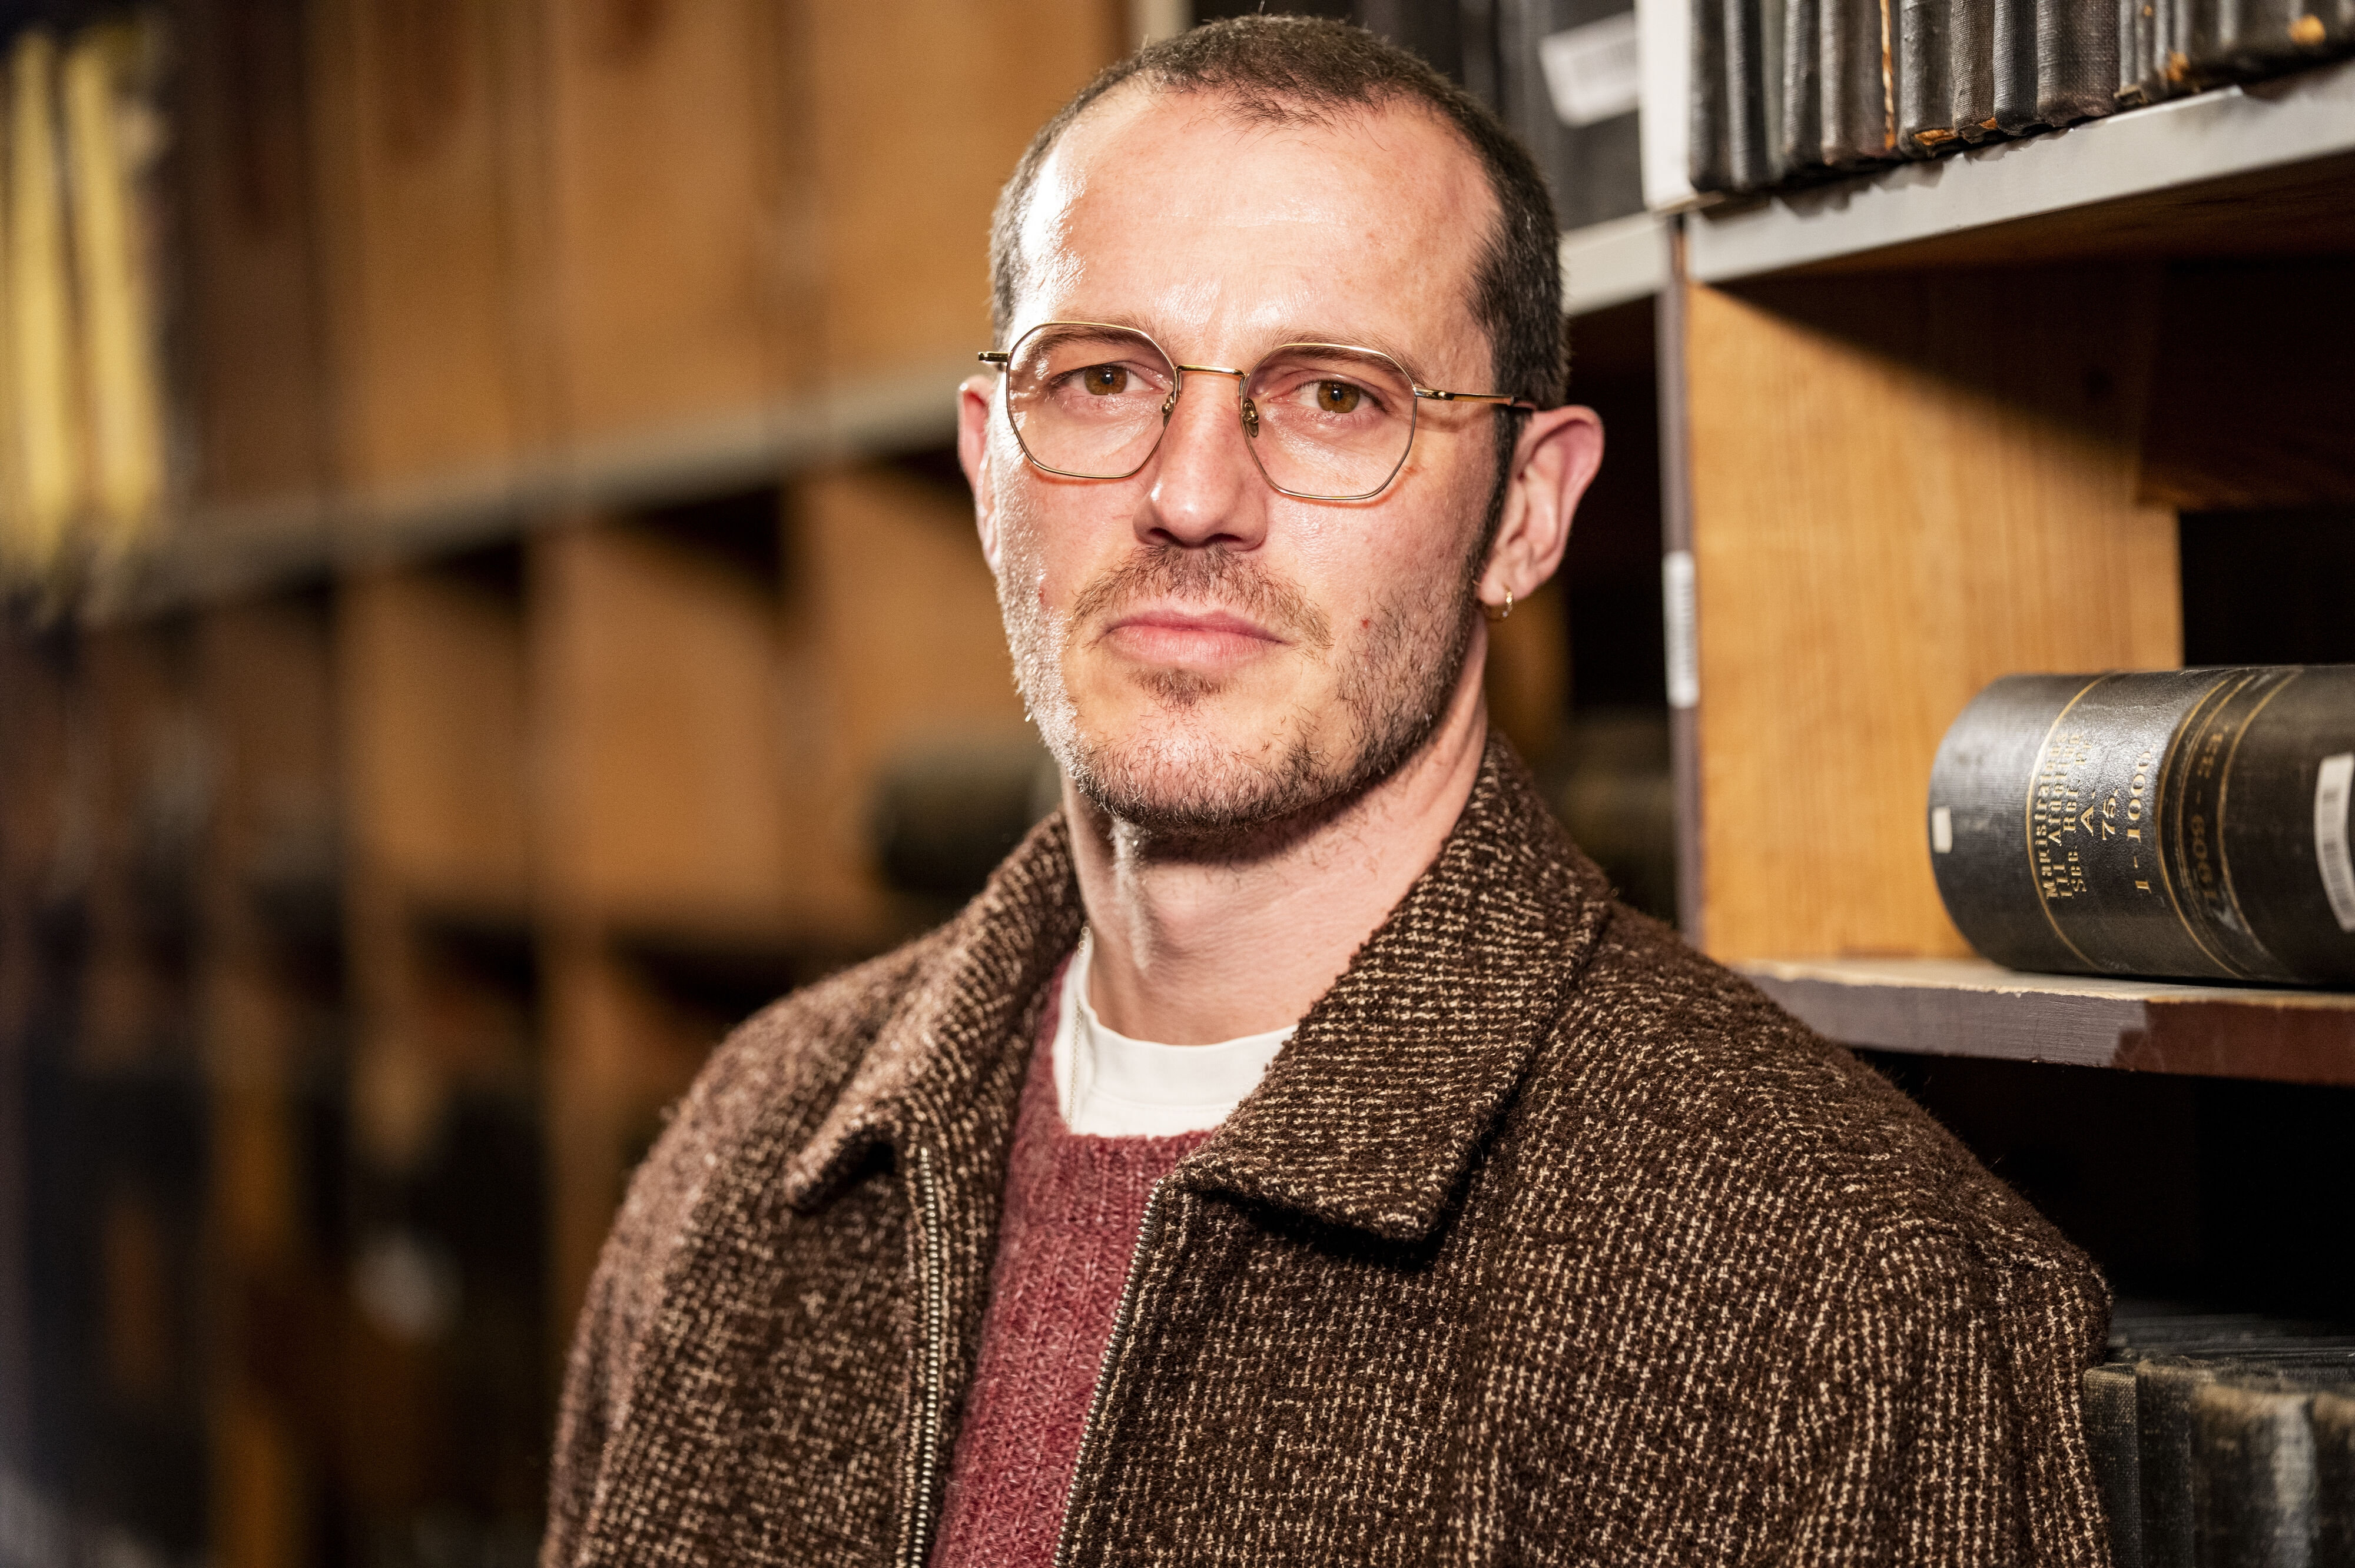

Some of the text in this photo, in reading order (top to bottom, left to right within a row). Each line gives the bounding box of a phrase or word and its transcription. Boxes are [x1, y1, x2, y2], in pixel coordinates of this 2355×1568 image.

[2081, 790, 2095, 836] A.
[2102, 789, 2118, 841] 75.
[2127, 744, 2156, 843] 1000.
[2052, 863, 2074, 899] III
[2135, 879, 2152, 894] 1
